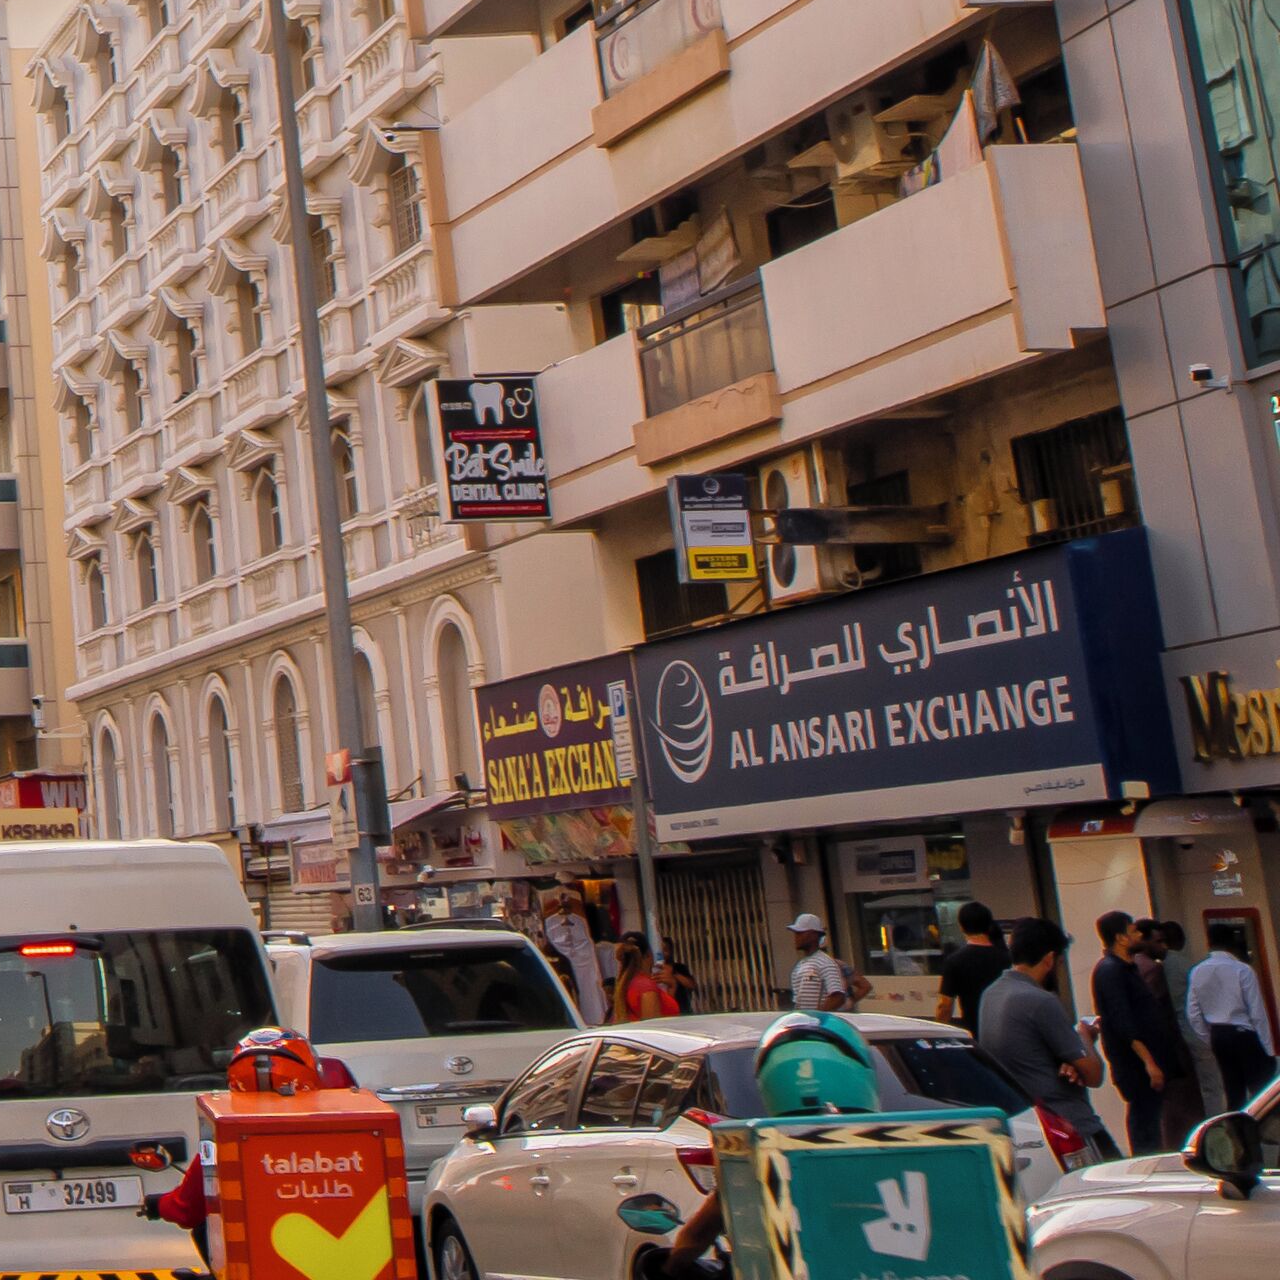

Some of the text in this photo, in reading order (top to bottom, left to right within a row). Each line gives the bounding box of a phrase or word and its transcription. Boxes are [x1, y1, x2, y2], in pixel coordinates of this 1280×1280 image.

[445, 442, 545, 481] Best Smile
[451, 483, 546, 501] DENTAL CLINIC
[718, 571, 1059, 696] الأنصاري للصرافة
[730, 676, 1075, 769] AL ANSARI EXCHANGE
[488, 739, 631, 805] SANA'A EXCHAN
[357, 886, 373, 903] 63
[260, 1151, 364, 1176] talabat
[18, 1181, 117, 1210] H 32499
[276, 1178, 354, 1204] طلبات
